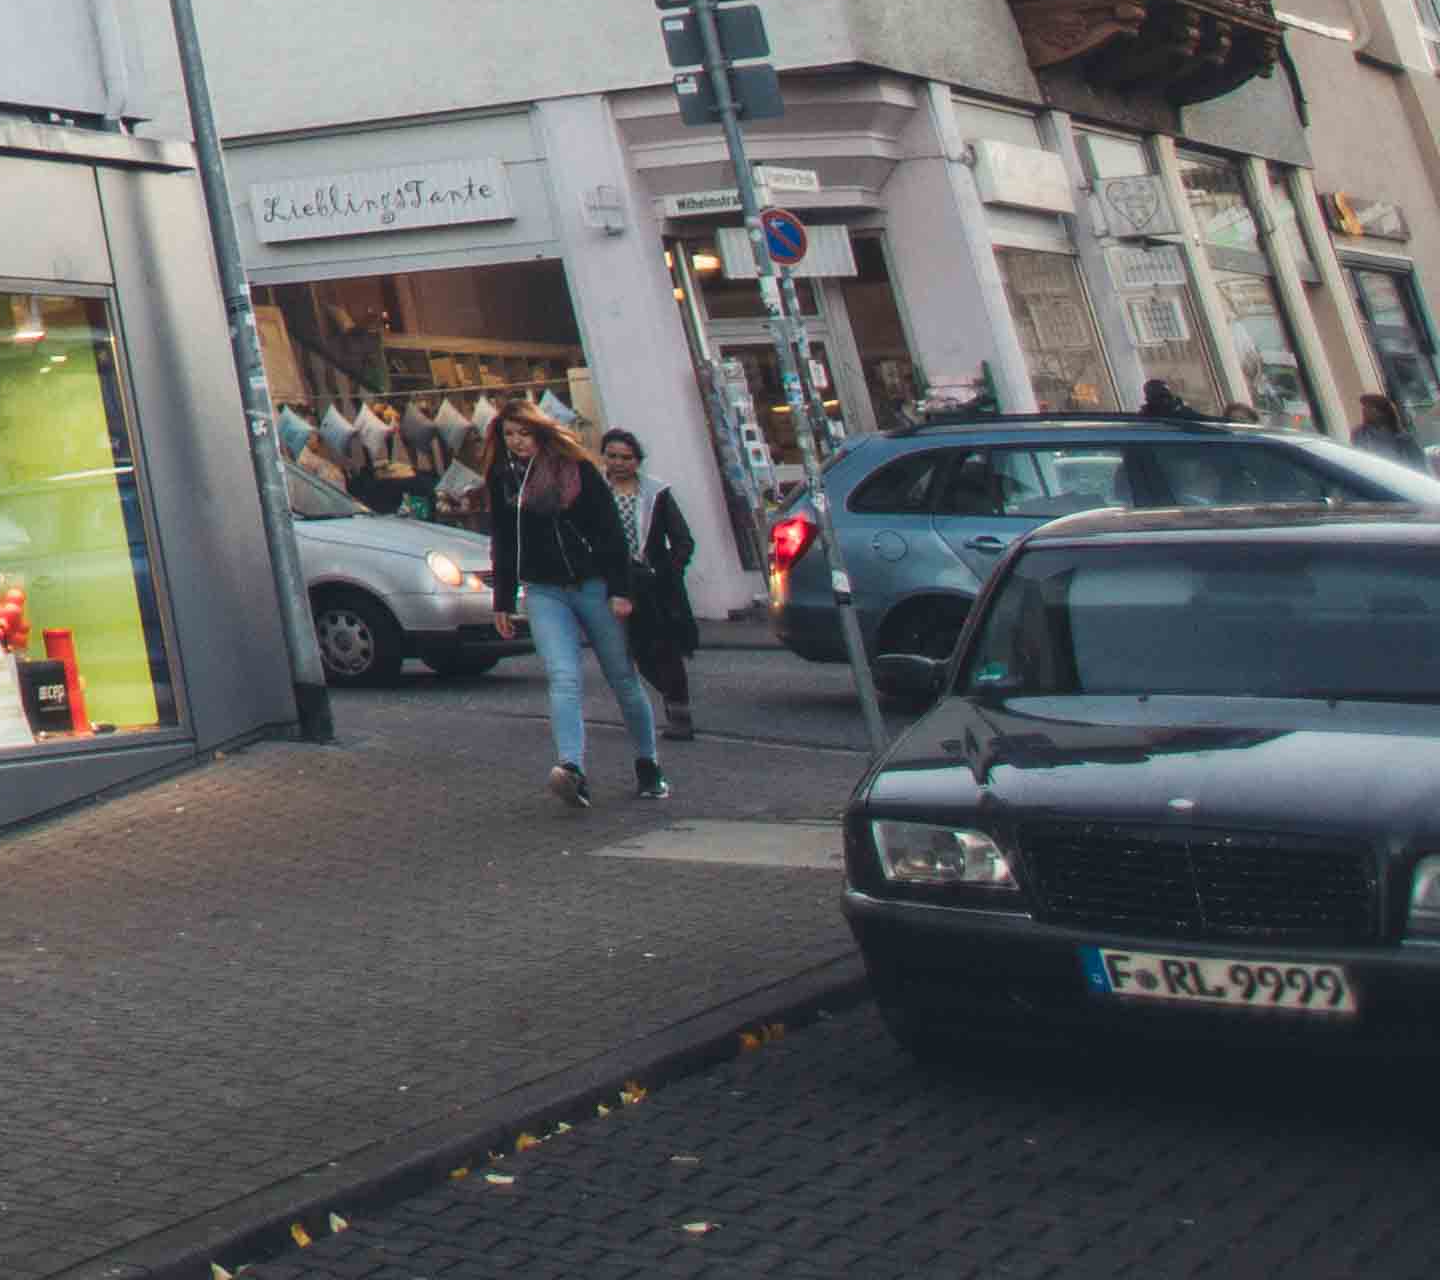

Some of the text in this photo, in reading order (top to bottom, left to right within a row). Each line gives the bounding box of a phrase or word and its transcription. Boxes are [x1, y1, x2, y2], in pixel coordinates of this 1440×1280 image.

[1104, 953, 1347, 1008] F RL 9999
